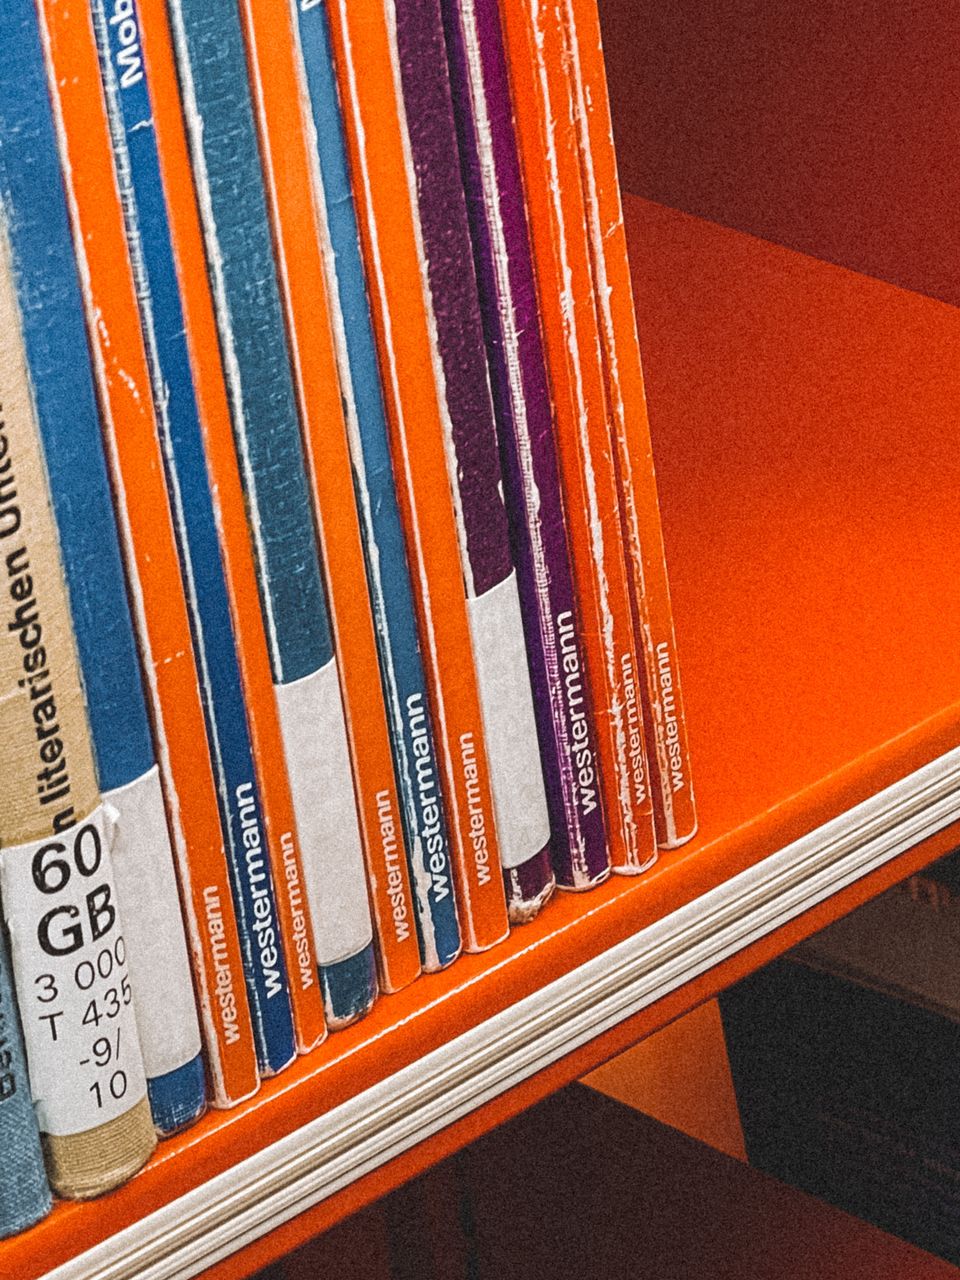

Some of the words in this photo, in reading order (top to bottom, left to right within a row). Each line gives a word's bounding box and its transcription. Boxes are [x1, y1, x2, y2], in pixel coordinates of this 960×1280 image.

[6, 546, 71, 805] literarischen
[557, 611, 598, 815] westermann
[621, 653, 646, 806] westermann
[655, 641, 685, 792] westermann
[31, 823, 102, 895] 60
[376, 789, 411, 943] westermann
[406, 692, 446, 903] westermann
[458, 732, 491, 887] westermann
[37, 882, 116, 957] GB
[203, 885, 240, 1046] westermann
[237, 782, 282, 1000] westermann
[280, 832, 315, 992] westermann
[34, 973, 59, 1003] 3
[74, 935, 127, 990] 000
[38, 1011, 64, 1042] T
[81, 974, 132, 1029] 435
[79, 1027, 121, 1067] -9/
[89, 1070, 128, 1108] 10
